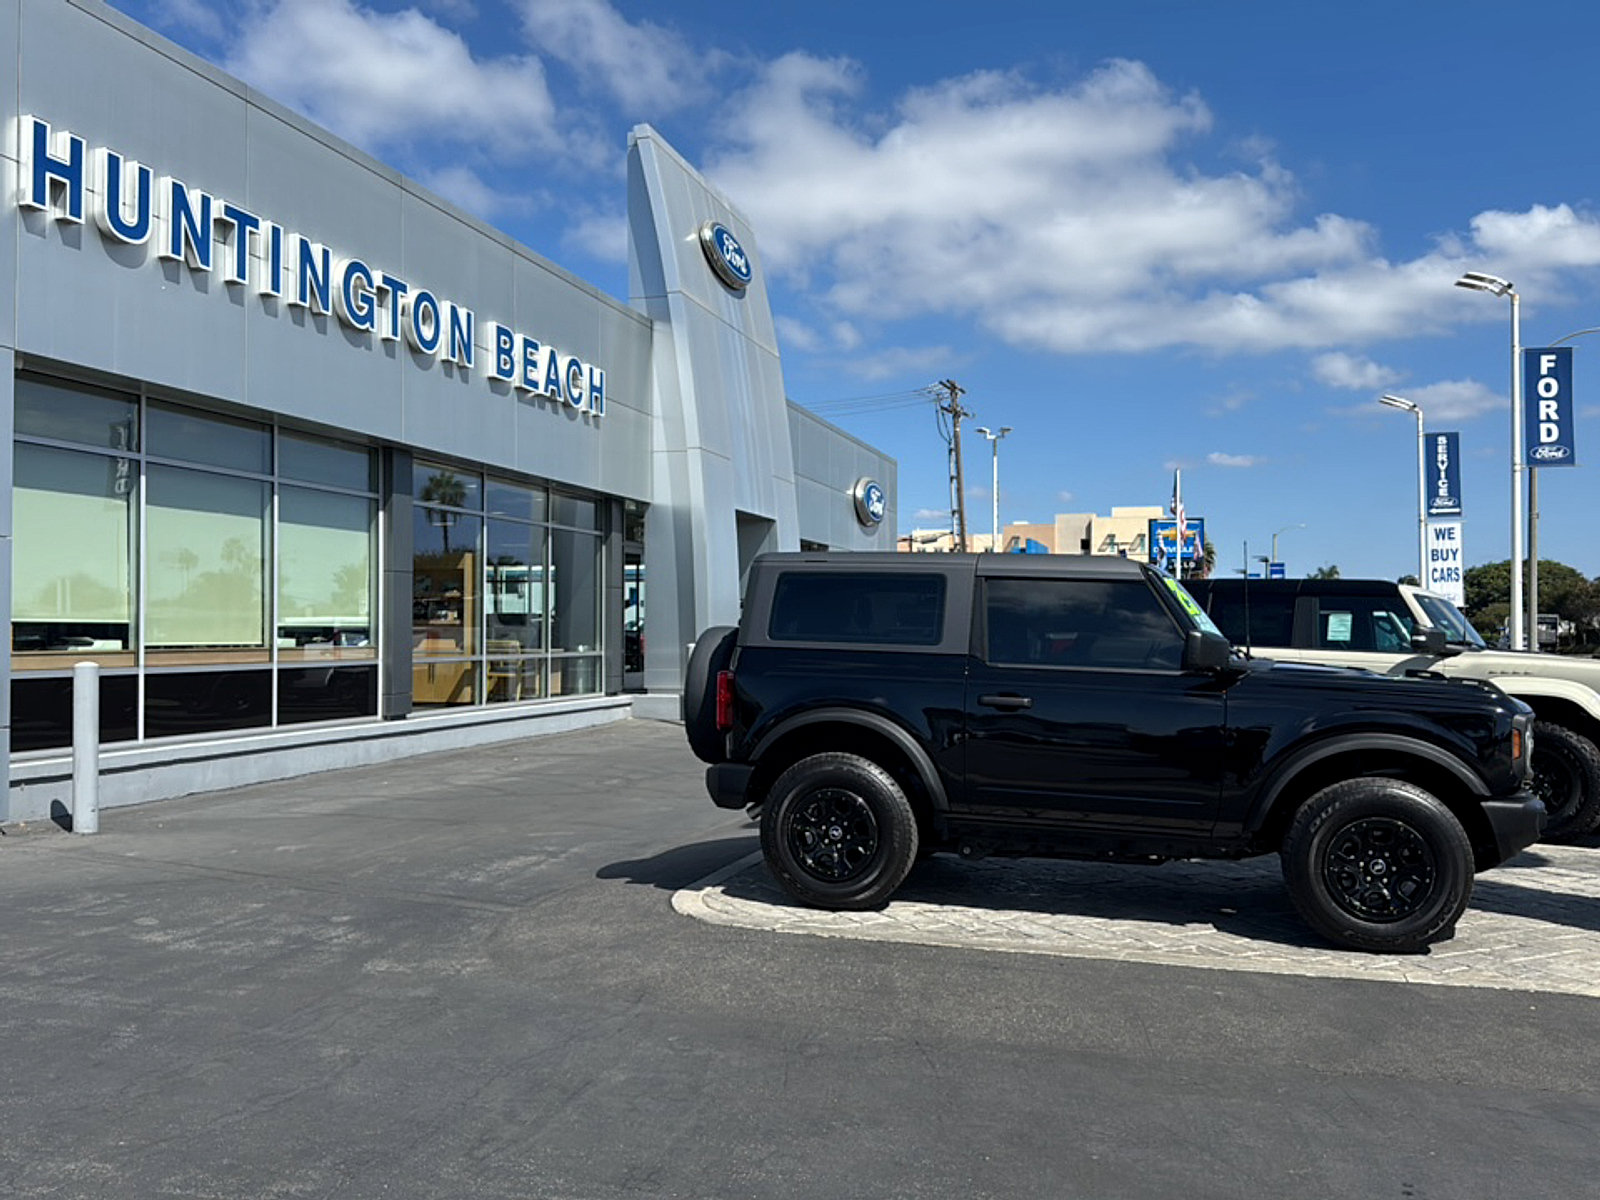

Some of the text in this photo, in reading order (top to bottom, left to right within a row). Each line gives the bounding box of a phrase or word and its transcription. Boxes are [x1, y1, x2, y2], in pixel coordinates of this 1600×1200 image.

[20, 114, 605, 417] HUNTINGTON BEACH
[723, 233, 747, 274] Ford
[1537, 354, 1560, 443] FORD
[1436, 435, 1449, 497] SERVICE
[1535, 446, 1565, 460] Ford
[1434, 527, 1456, 540] WE
[1431, 548, 1459, 562] BUY
[1431, 566, 1461, 583] CARS
